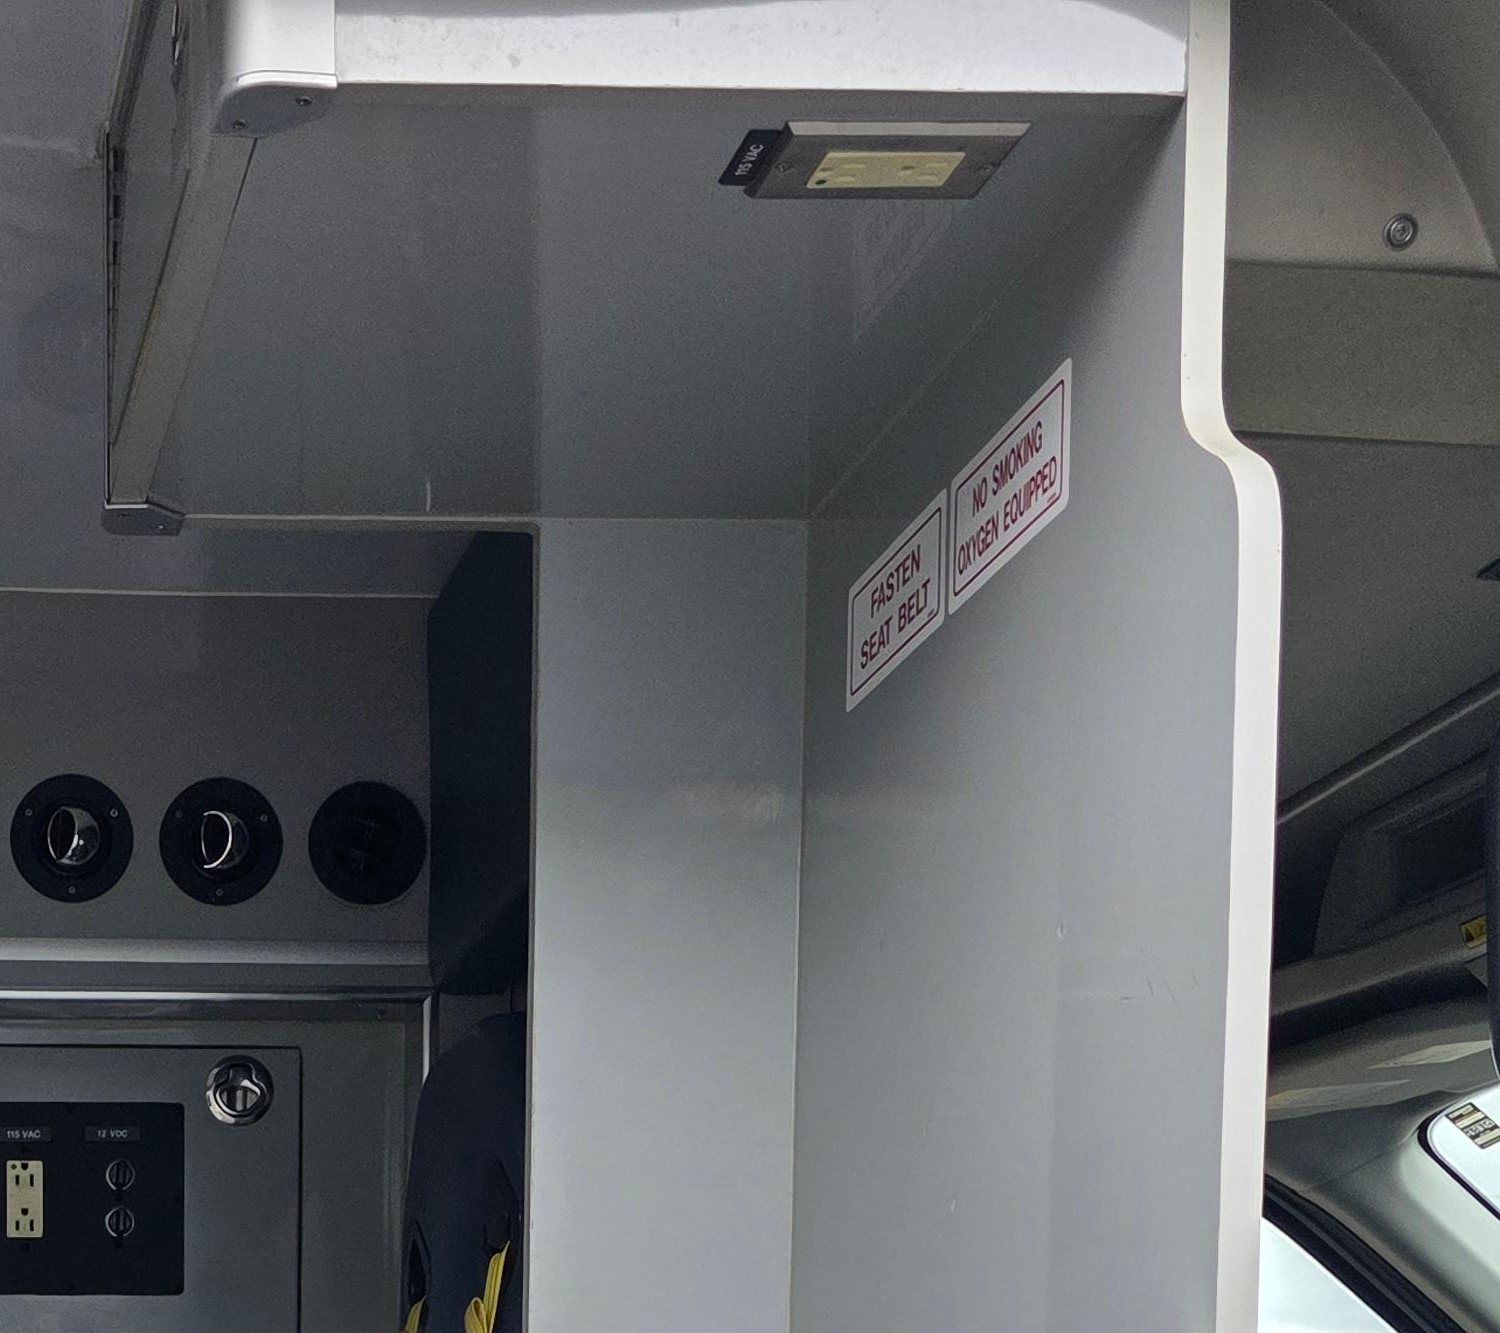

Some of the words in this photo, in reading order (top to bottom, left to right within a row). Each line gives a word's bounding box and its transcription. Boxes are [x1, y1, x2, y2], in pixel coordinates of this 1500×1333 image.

[741, 144, 764, 162] VAC
[972, 477, 988, 517] NO
[991, 420, 1043, 496] SMOKING
[956, 514, 999, 576] OXYGEN
[1002, 455, 1058, 532] EQUIPPED
[870, 543, 922, 619] FASTEN
[859, 618, 892, 670] SEAT
[897, 577, 931, 635] BELT
[6, 1130, 20, 1139] 115
[21, 1129, 41, 1139] VAC
[97, 1130, 107, 1139] 12
[109, 1129, 128, 1139] VDC
